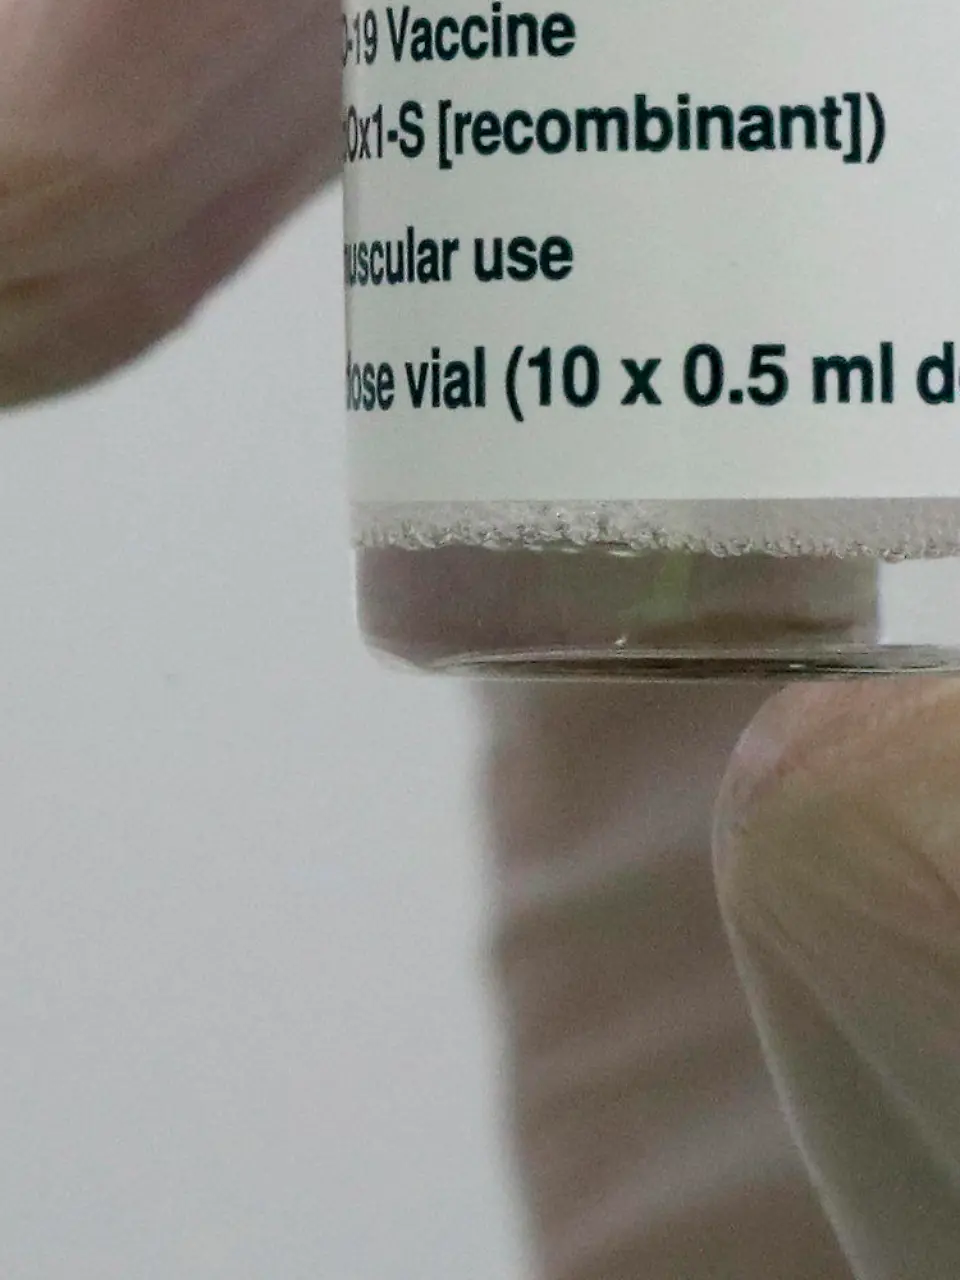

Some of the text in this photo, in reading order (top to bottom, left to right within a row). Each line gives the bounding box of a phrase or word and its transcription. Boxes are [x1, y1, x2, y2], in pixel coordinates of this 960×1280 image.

[385, 0, 577, 63] Vaccine
[344, 91, 887, 171] Ox1-S [recombinant])
[345, 225, 574, 288] uscular use
[404, 345, 487, 410] vial
[504, 344, 600, 423] (10
[620, 357, 663, 407] x
[682, 342, 789, 408] 0.5
[811, 340, 896, 406] ml
